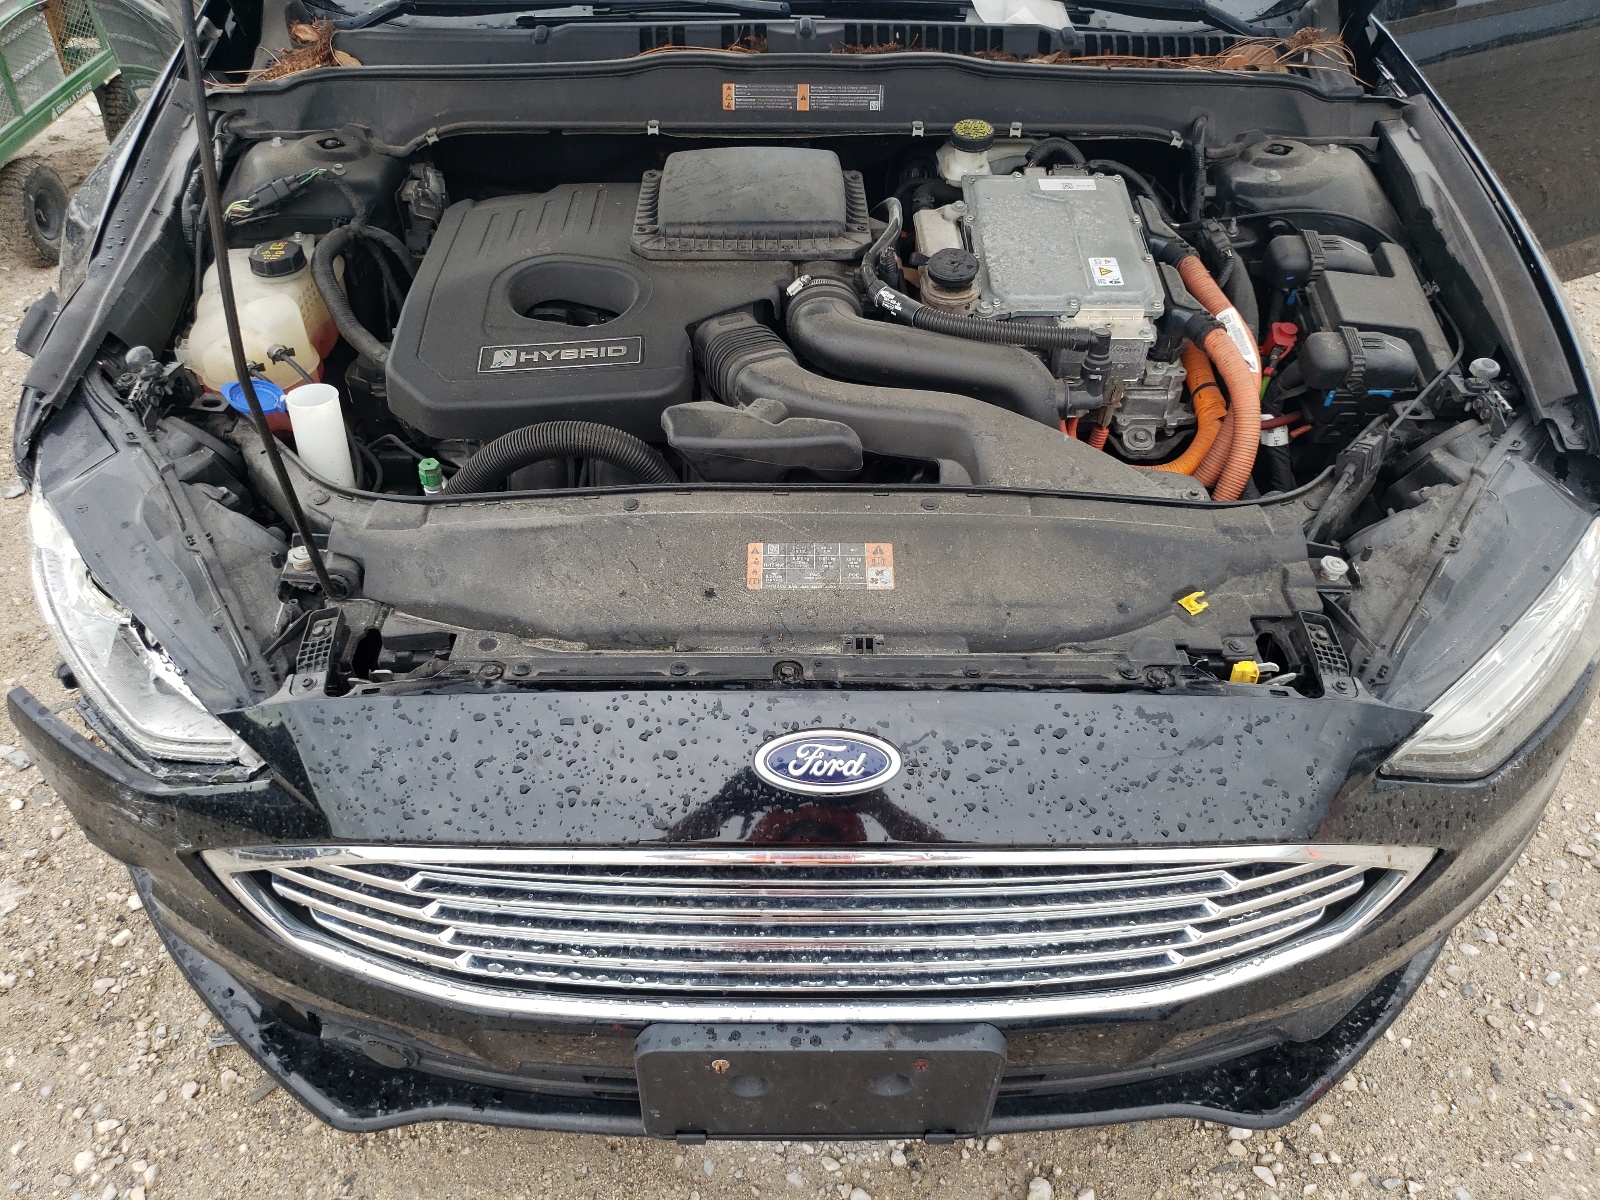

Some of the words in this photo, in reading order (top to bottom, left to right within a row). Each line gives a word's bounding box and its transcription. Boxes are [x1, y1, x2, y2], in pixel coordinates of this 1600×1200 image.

[56, 94, 77, 115] GORILLA
[76, 81, 92, 99] CARTS
[519, 345, 628, 362] HYBRID
[788, 743, 867, 776] Ford
